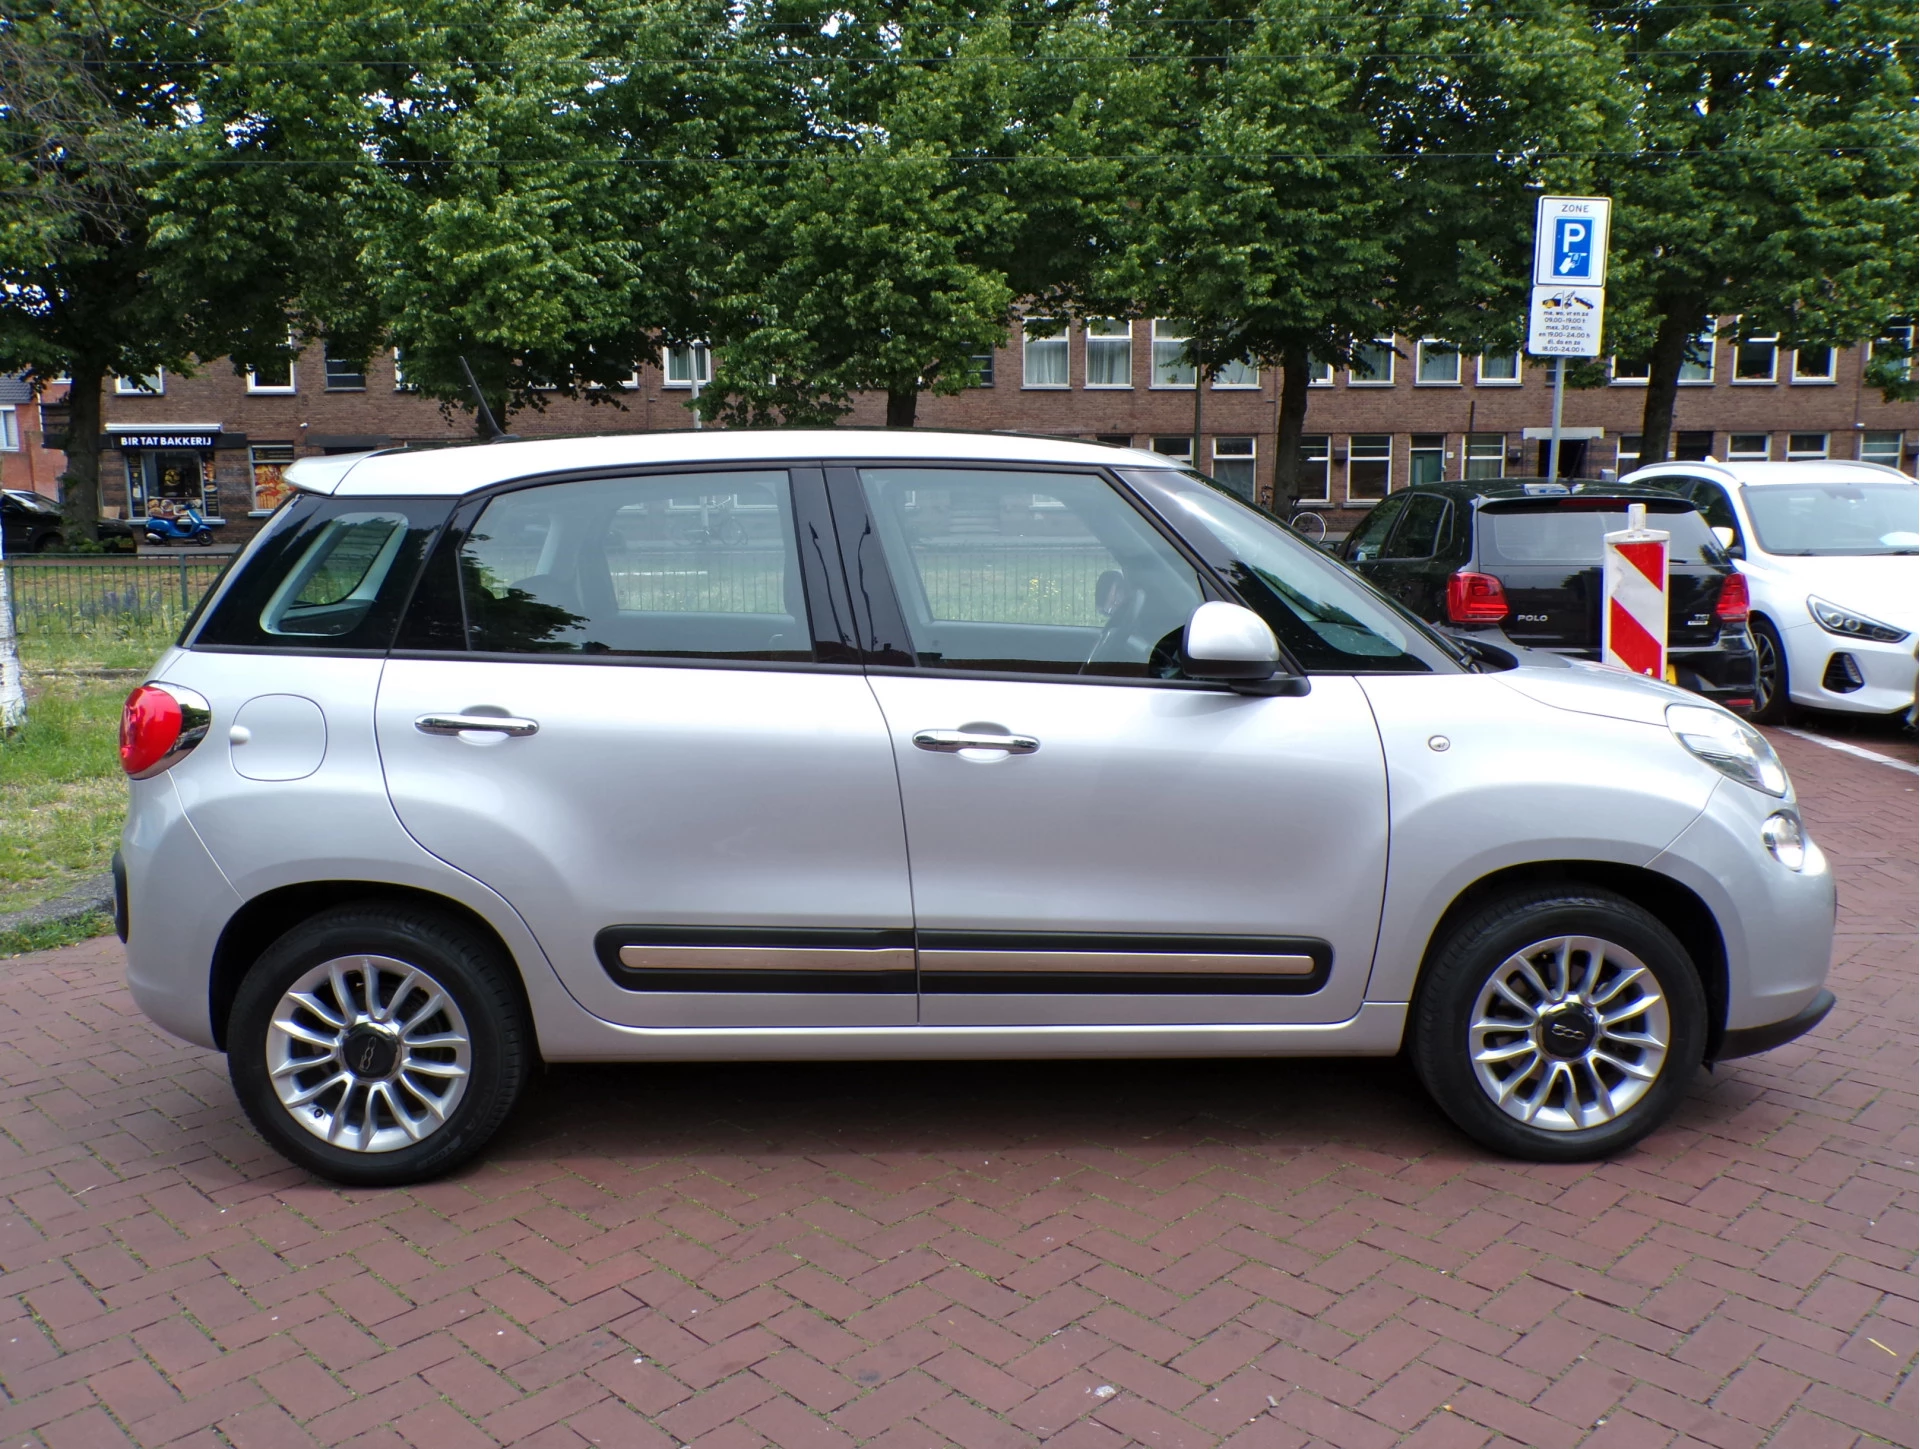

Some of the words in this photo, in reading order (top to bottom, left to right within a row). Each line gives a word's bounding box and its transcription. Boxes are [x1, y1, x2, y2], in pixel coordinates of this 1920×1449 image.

[1561, 204, 1589, 213] ZONE
[1562, 223, 1586, 253] P
[120, 436, 139, 446] BIR
[140, 436, 158, 446] TAT
[160, 436, 211, 446] BAKKERIJ
[1517, 614, 1548, 622] POLO
